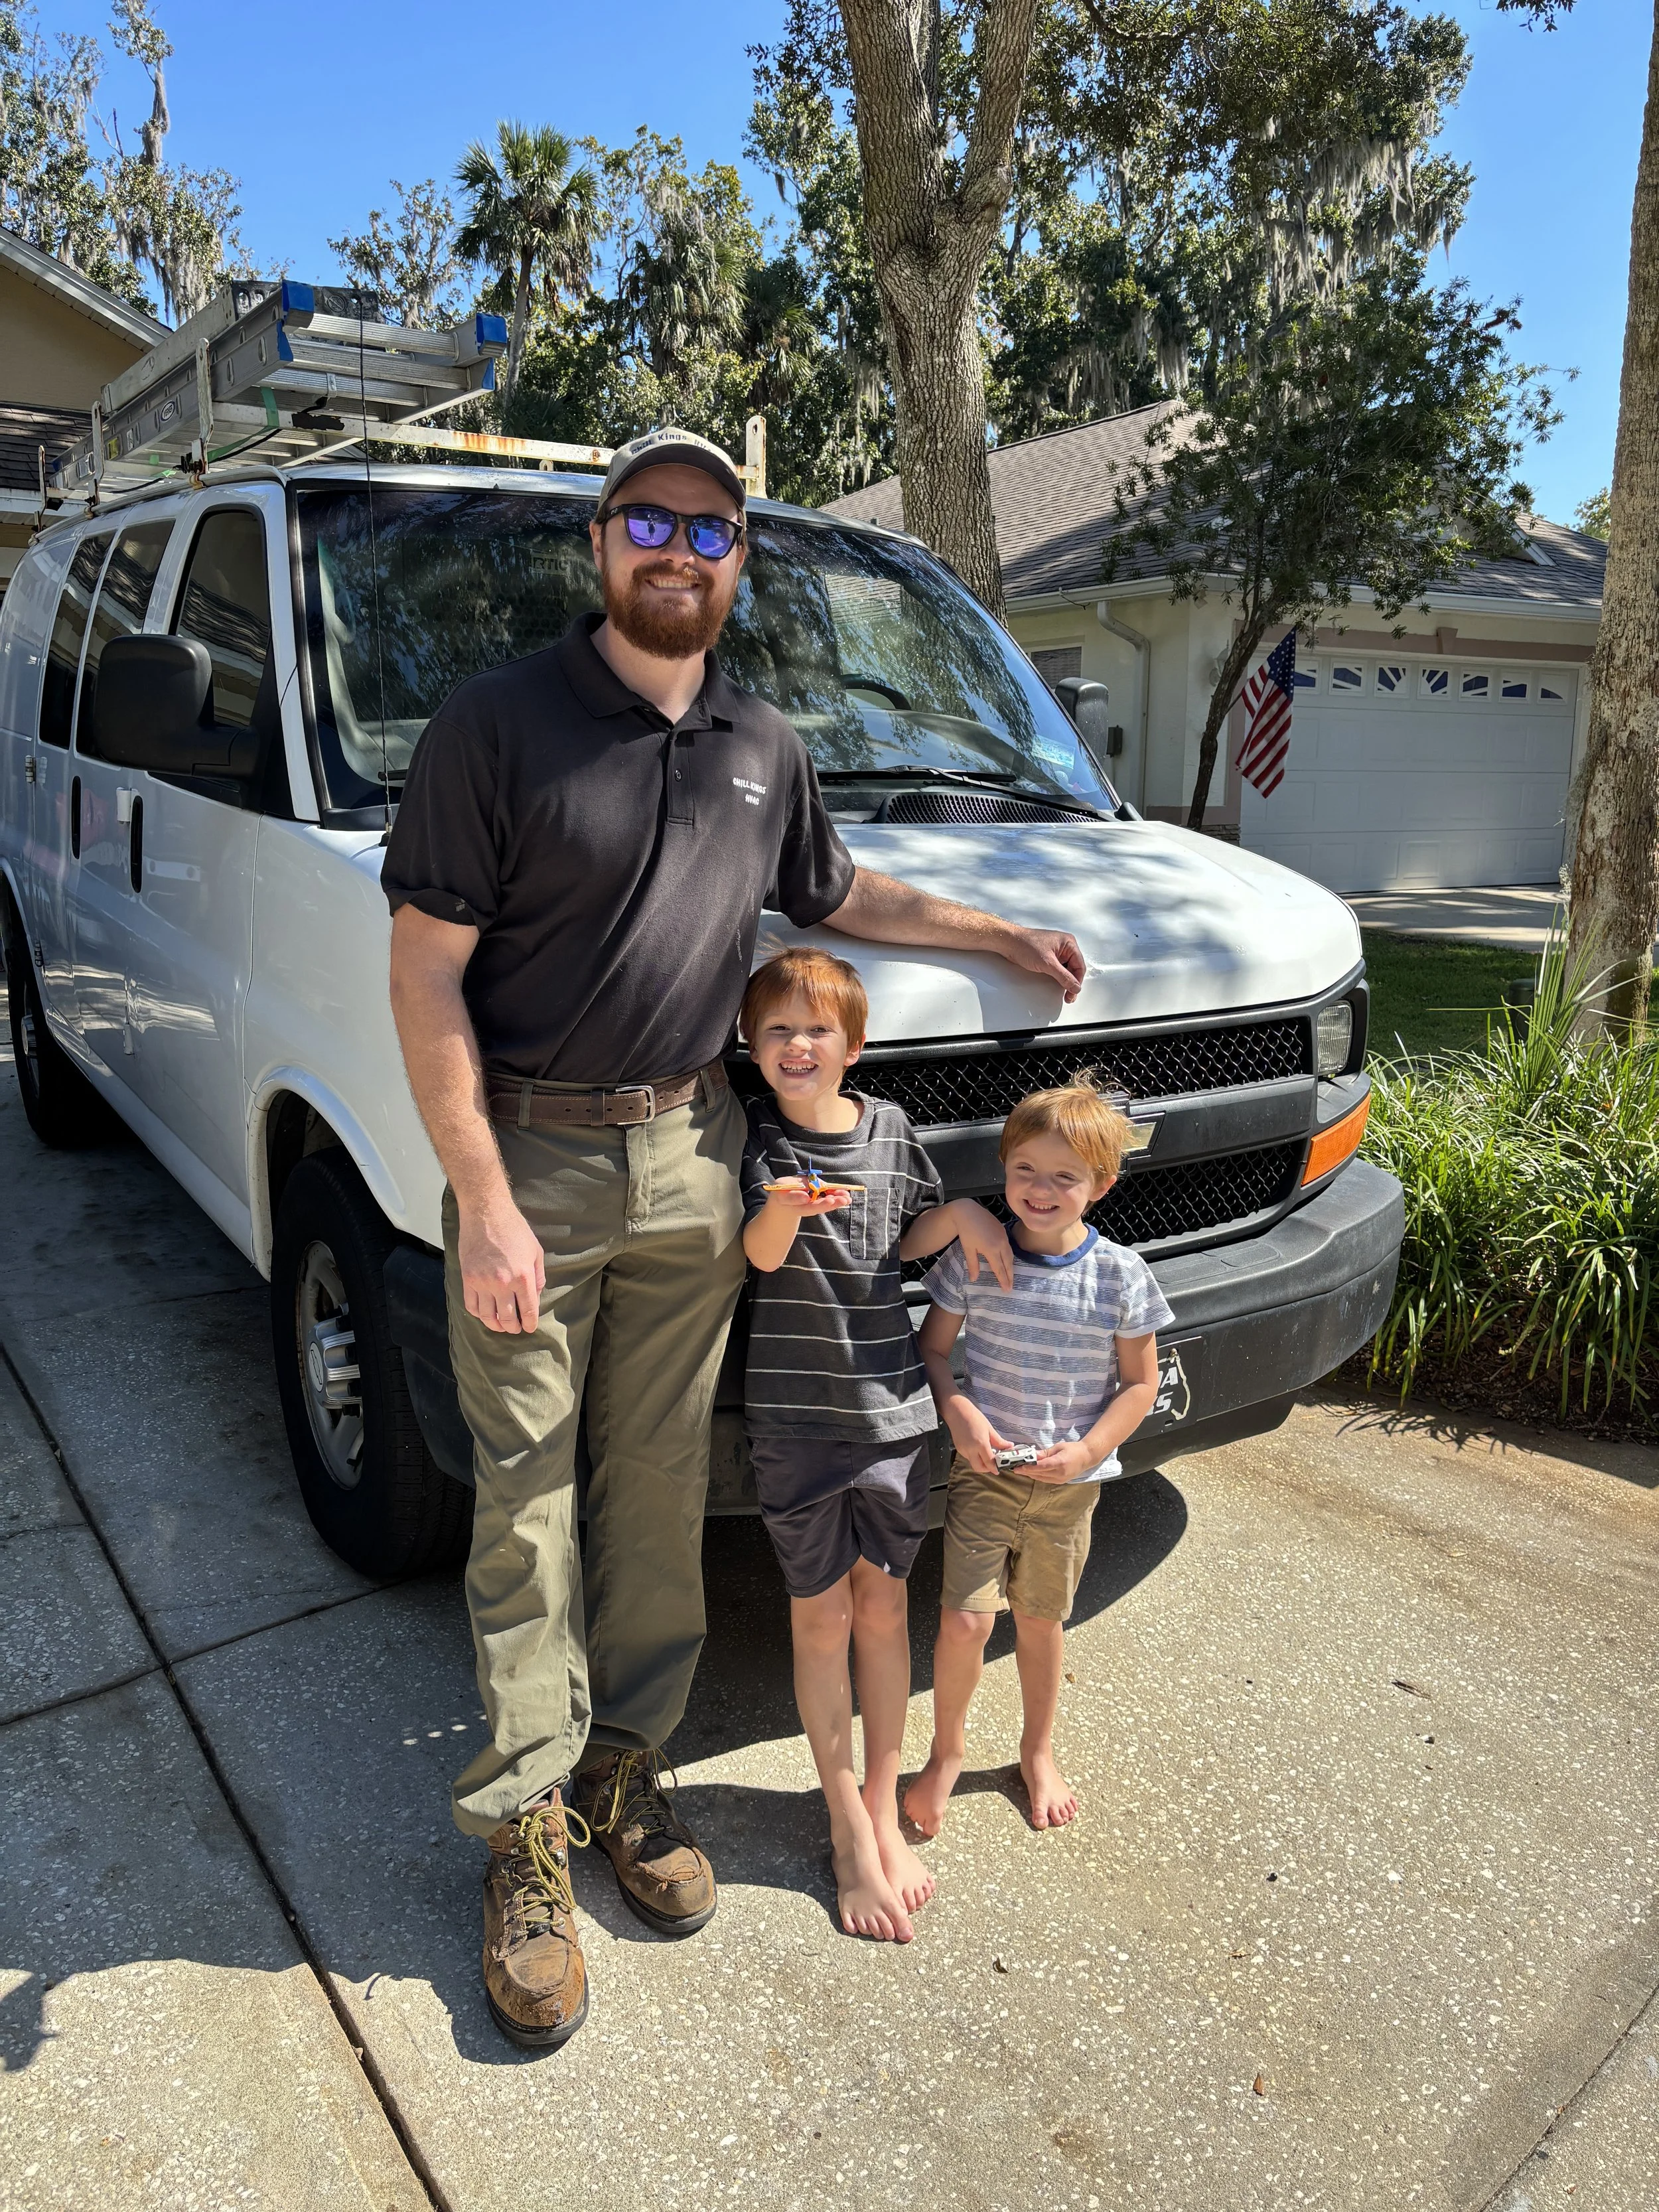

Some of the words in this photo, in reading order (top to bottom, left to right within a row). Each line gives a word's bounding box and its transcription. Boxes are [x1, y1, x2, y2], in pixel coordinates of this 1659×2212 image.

[733, 777, 750, 788] CHILL
[750, 781, 767, 794] KINGS
[745, 794, 760, 806] HVAC
